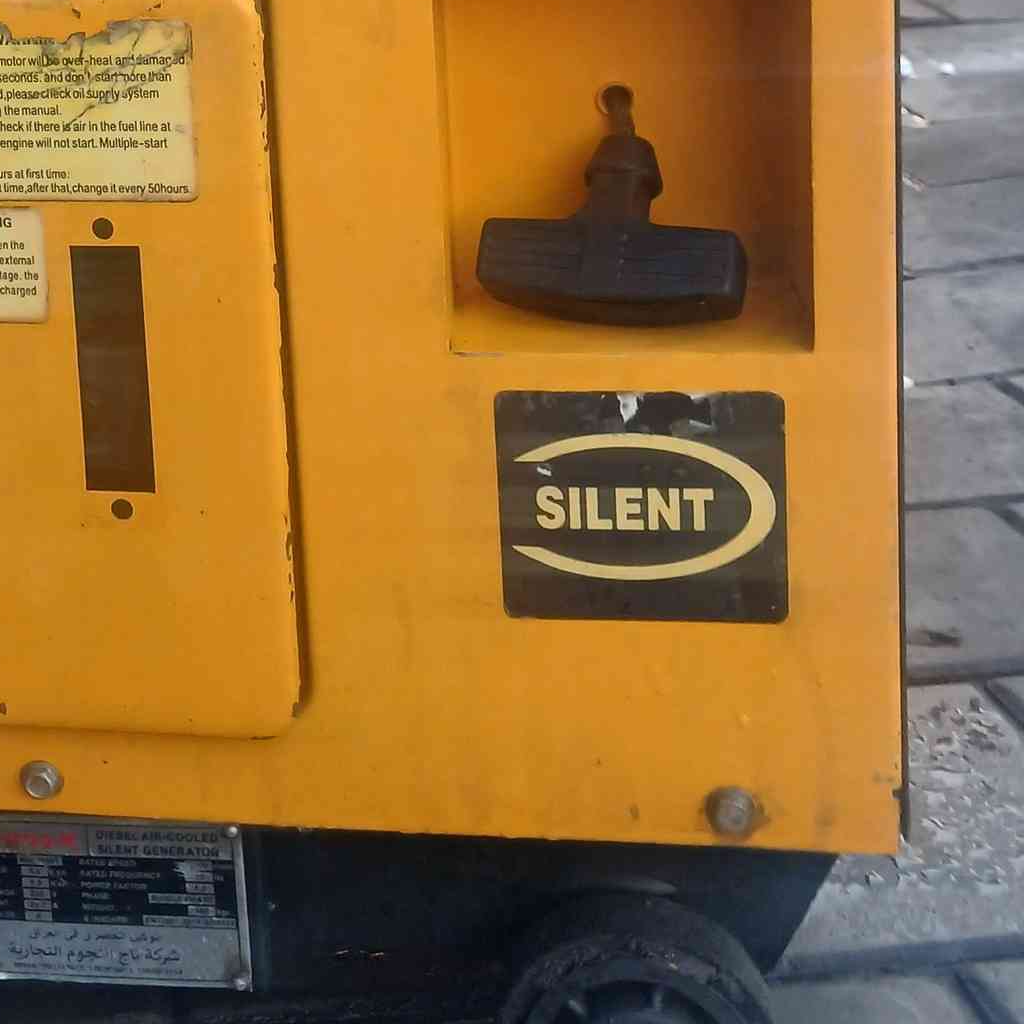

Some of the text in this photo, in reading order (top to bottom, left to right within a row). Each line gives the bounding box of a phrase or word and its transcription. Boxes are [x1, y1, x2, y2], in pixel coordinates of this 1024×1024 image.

[62, 55, 113, 66] over-heat
[45, 72, 63, 82] and
[73, 88, 85, 99] oil
[4, 105, 20, 115] the
[21, 105, 62, 115] manual.
[34, 121, 60, 131] there
[73, 121, 86, 131] air
[100, 121, 117, 131] the
[119, 121, 138, 131] fuel
[140, 121, 158, 131] line
[161, 121, 171, 131] at
[0, 139, 34, 152] engine
[36, 138, 52, 148] will
[54, 139, 70, 148] not
[100, 138, 168, 151] Multiple-start
[15, 170, 24, 178] at
[26, 169, 44, 178] first
[111, 184, 117, 193] it
[119, 185, 145, 196] every
[11, 240, 25, 250] the
[0, 256, 35, 266] external
[25, 271, 39, 281] the
[0, 286, 37, 297] charged
[535, 484, 715, 532] SILENT
[97, 844, 221, 858] SILENT GENERATOR
